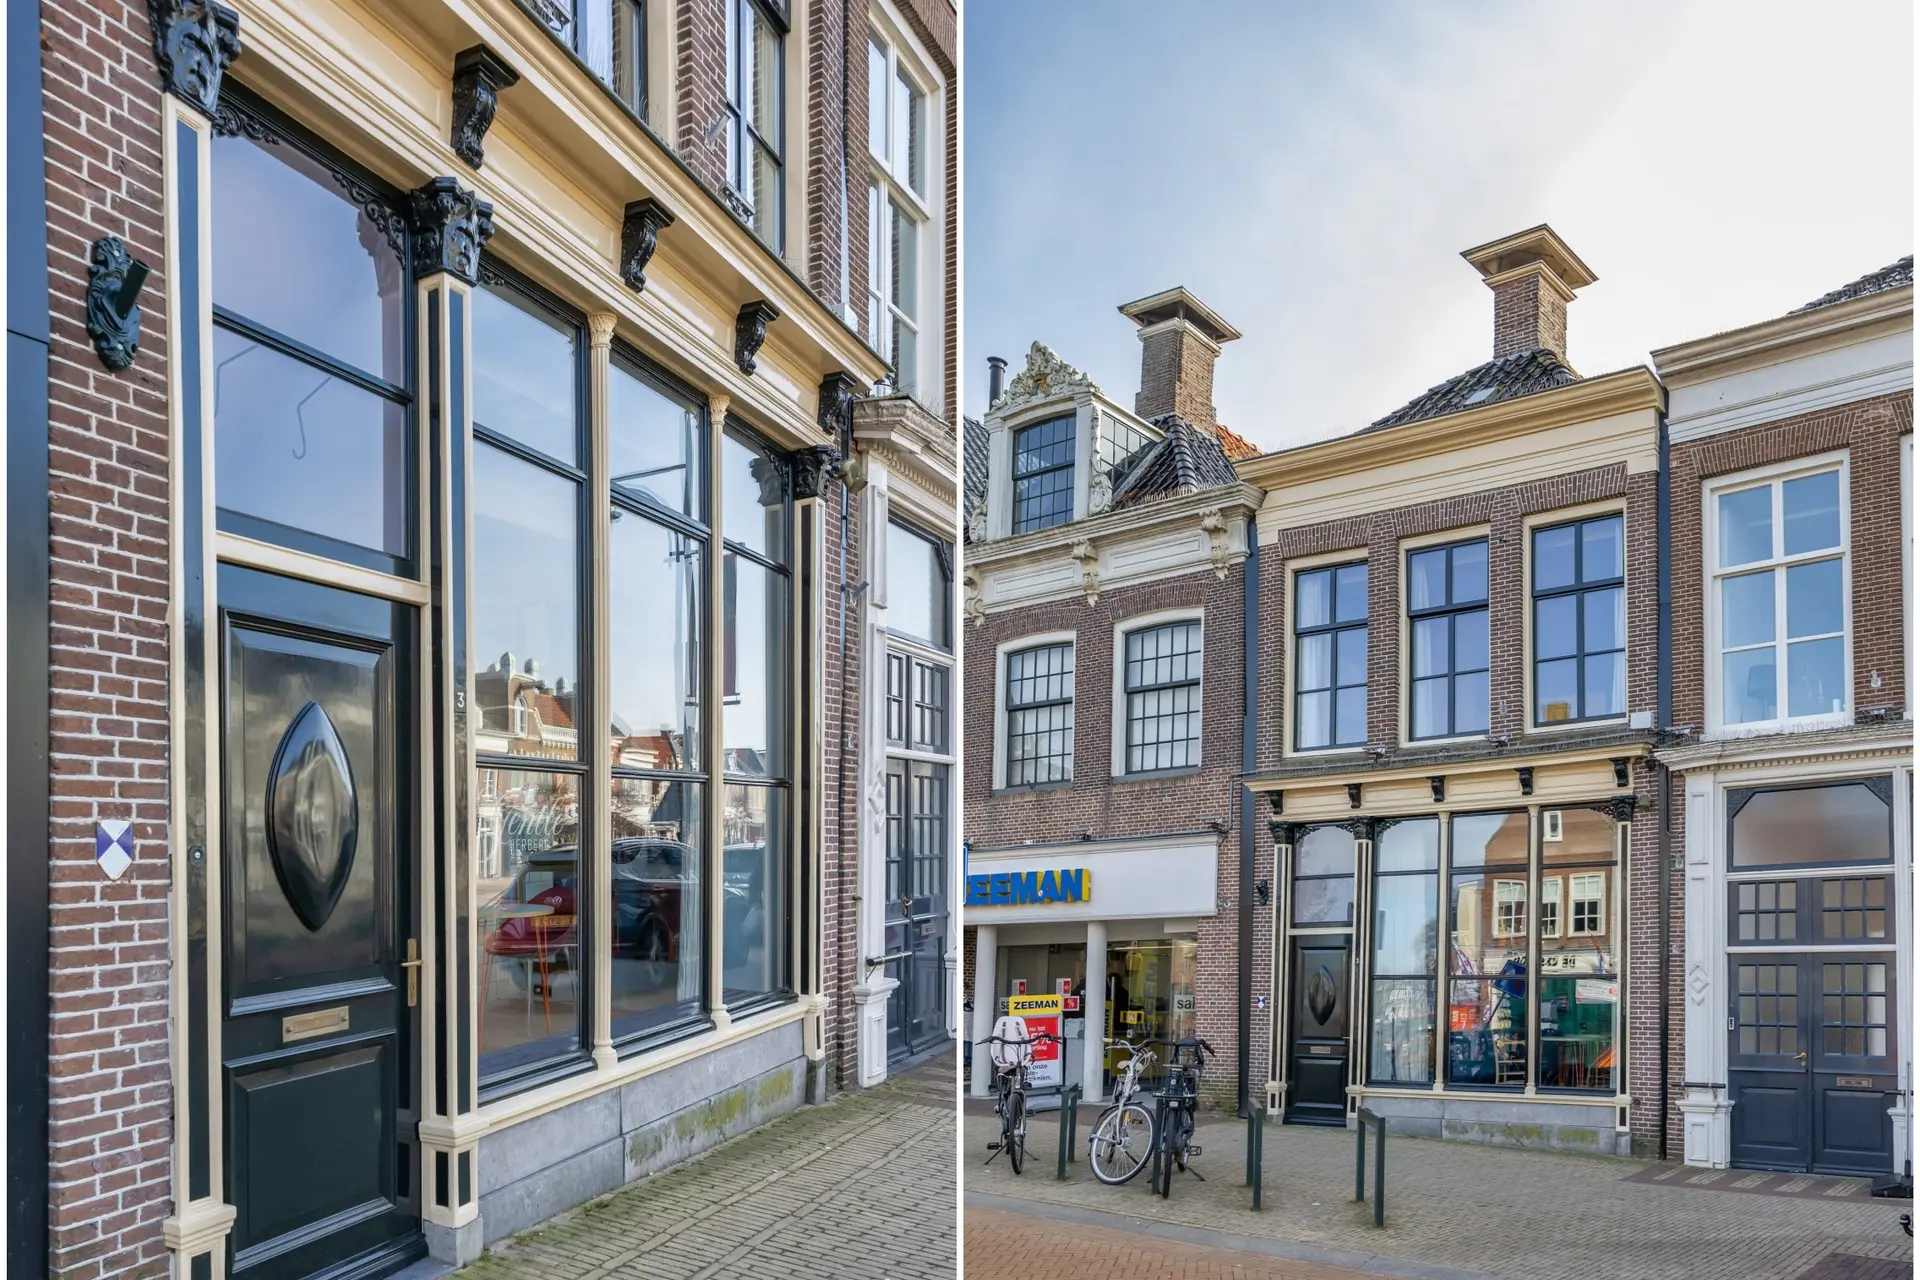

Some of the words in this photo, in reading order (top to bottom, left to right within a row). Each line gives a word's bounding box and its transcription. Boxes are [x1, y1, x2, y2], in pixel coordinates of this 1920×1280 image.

[457, 691, 466, 708] 3
[965, 868, 1088, 906] EEMAN
[1013, 999, 1059, 1010] ZEEMAN
